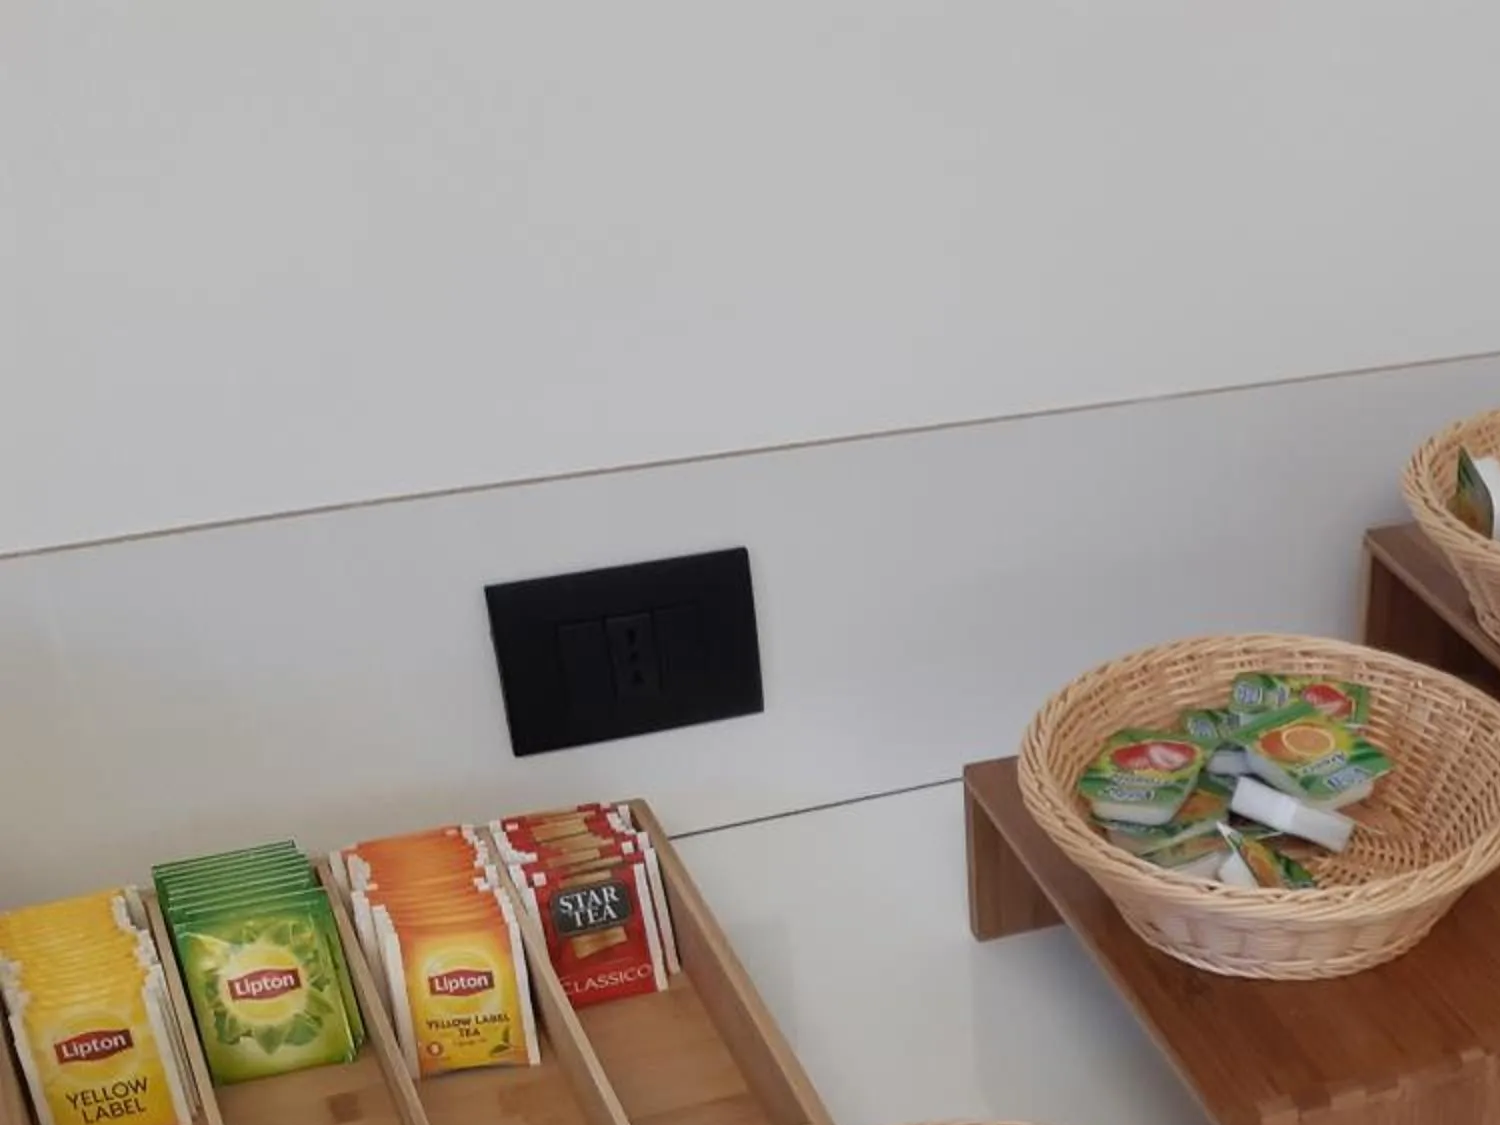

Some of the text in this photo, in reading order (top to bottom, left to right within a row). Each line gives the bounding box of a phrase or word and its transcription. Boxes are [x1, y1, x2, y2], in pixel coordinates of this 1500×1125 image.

[558, 885, 620, 914] STAR
[572, 905, 618, 928] TEA
[234, 973, 295, 997] Lipton
[433, 974, 489, 993] Lipton
[559, 964, 652, 995] CLASSICO
[426, 1013, 511, 1030] YELLOW LABEL
[459, 1027, 480, 1038] TEA
[61, 1032, 128, 1062] Lipton
[66, 1077, 148, 1110] YELLOW
[82, 1099, 147, 1125] LABEL
